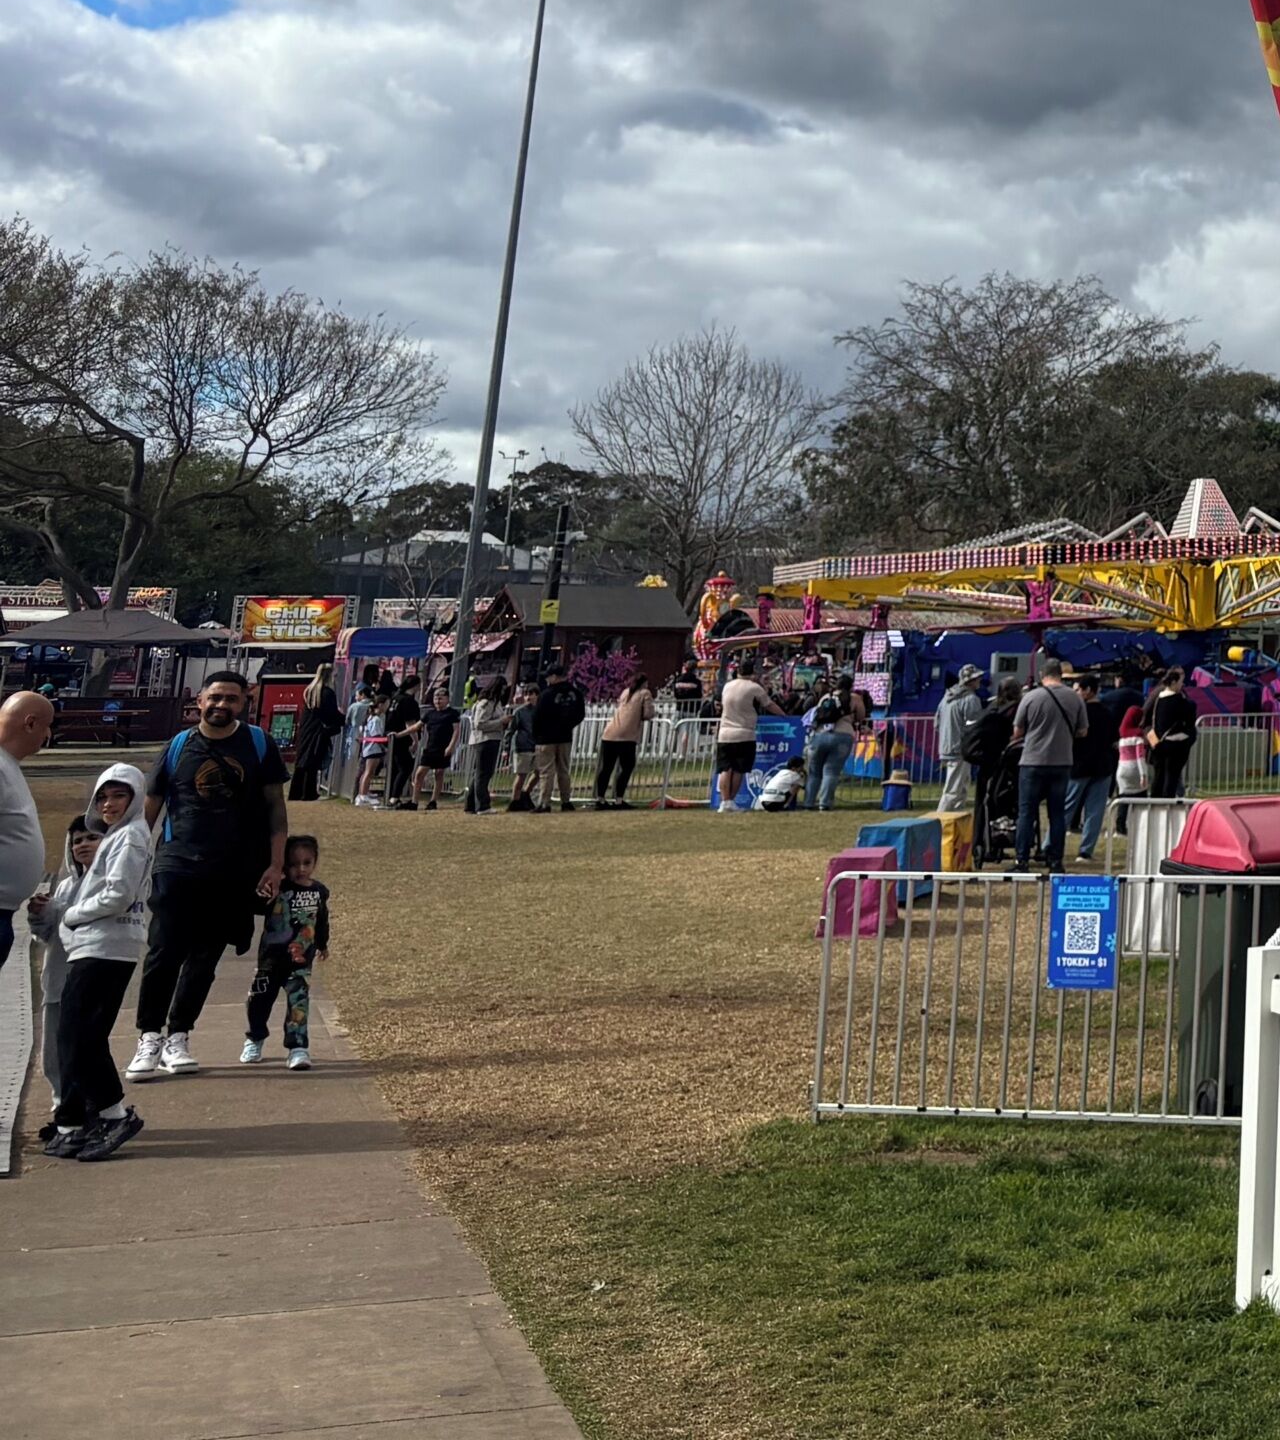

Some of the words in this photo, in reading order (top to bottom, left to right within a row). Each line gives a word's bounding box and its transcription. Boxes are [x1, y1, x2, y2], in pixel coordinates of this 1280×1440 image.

[265, 605, 323, 620] CHIP
[255, 624, 330, 639] STICK
[1077, 885, 1088, 893] THE
[1061, 956, 1089, 968] TOKEN
[1097, 956, 1107, 968] $1
